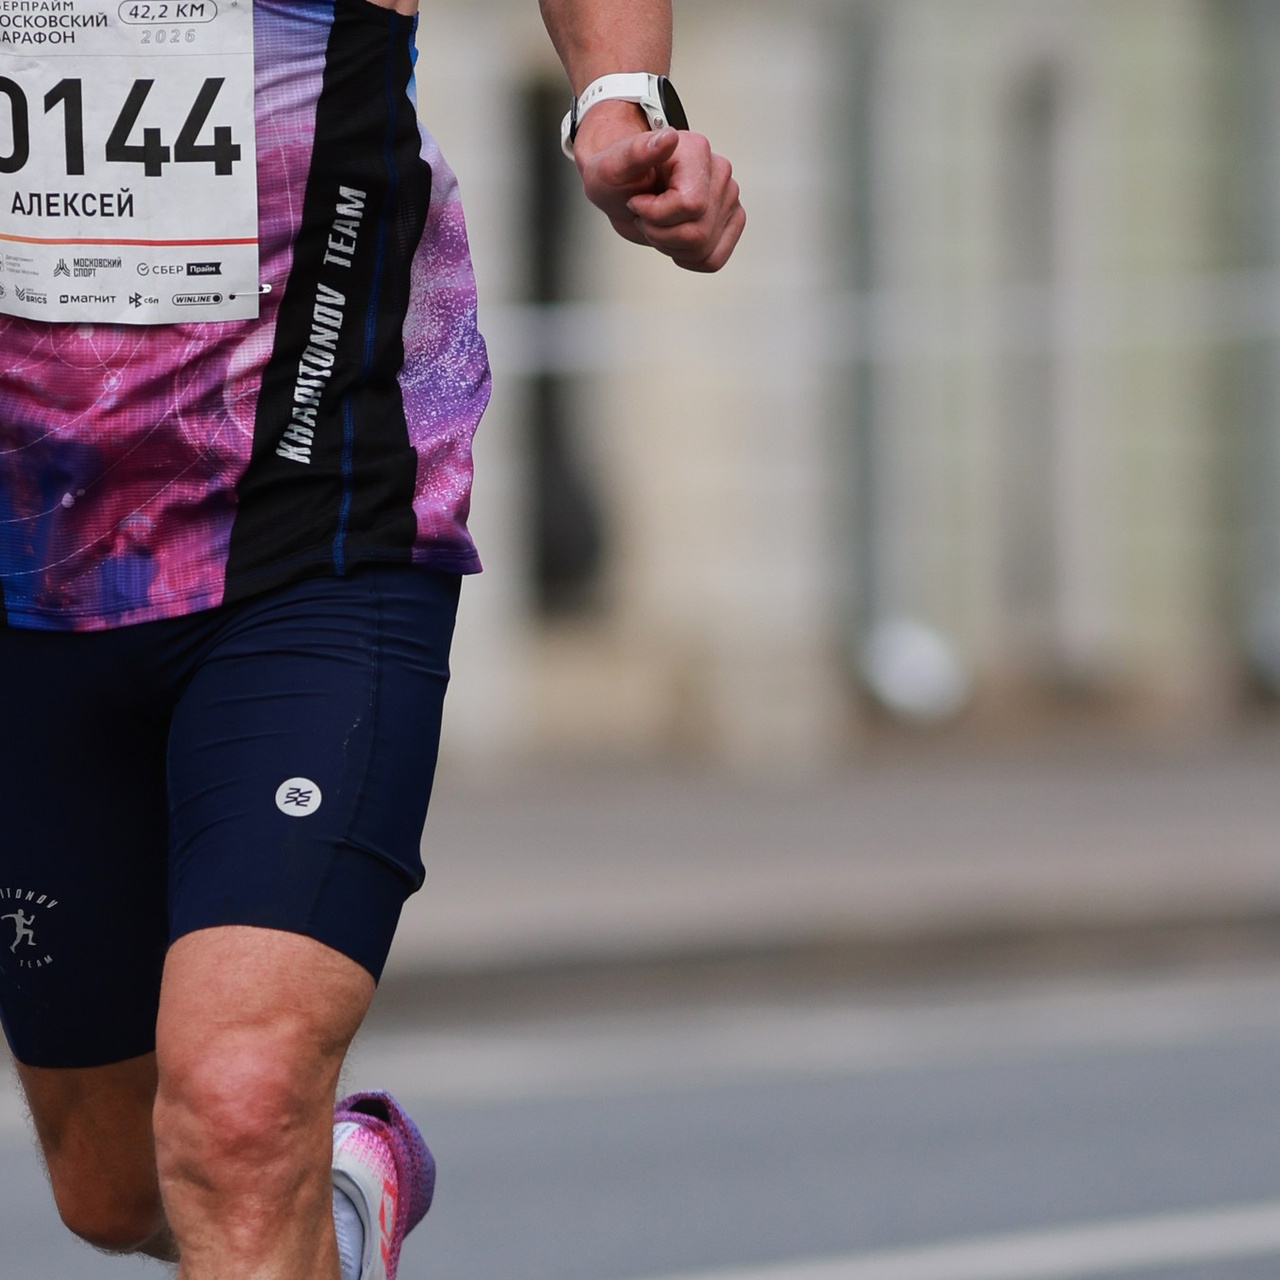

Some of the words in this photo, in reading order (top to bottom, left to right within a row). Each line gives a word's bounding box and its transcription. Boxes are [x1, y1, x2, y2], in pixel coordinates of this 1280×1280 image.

[129, 4, 168, 20] 42,2
[140, 29, 197, 45] 2026
[11, 188, 134, 218] АЛЕКСЕЙ
[73, 257, 122, 269] МОСКОВСКИЙ
[73, 269, 98, 277] СПОРТ
[152, 265, 184, 275] СБЕР
[26, 296, 47, 304] BRICS
[176, 295, 211, 303] WINLINE
[275, 282, 346, 465] KHARITONOV
[323, 185, 367, 268] TEAM
